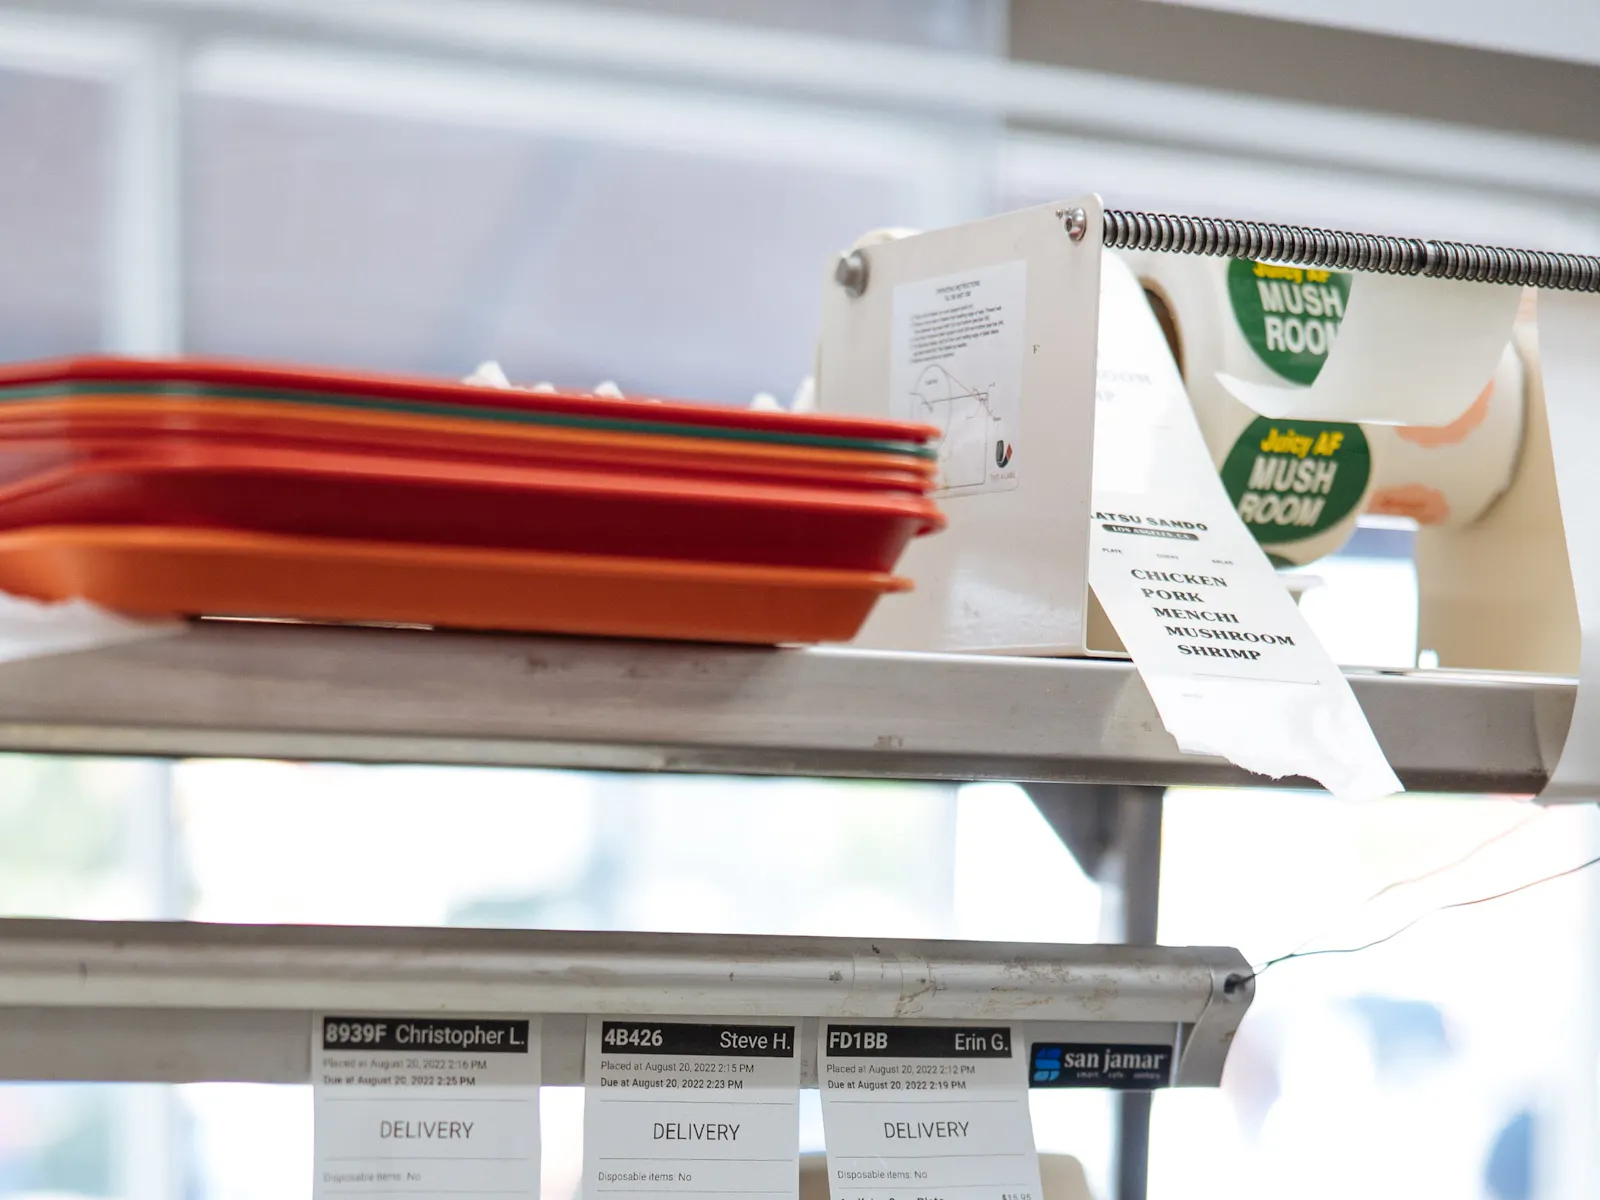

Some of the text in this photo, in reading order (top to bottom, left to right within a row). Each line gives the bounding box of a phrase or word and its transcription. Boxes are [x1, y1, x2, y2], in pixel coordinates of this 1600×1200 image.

[1257, 280, 1344, 318] MUSH
[1260, 427, 1344, 458] Juicy AF
[1248, 454, 1338, 495] MUSH
[1237, 492, 1326, 526] ROOM
[1091, 512, 1208, 530] ATSU SANDO
[1131, 569, 1227, 587] CHICKEN
[1141, 588, 1205, 603] PORK
[1153, 607, 1240, 623] MENCHI
[1165, 626, 1295, 646] MUSHROOM
[1178, 644, 1261, 660] SHRIMP
[326, 1023, 524, 1047] 8939F Christopher L.
[605, 1029, 790, 1050] 4B426 Steve H.
[829, 1032, 1008, 1051] FD1BB Erin G.
[601, 1062, 631, 1071] Placed
[634, 1063, 642, 1071] at
[646, 1063, 676, 1073] August
[695, 1064, 715, 1072] 2022
[718, 1064, 737, 1073] 2:15
[740, 1064, 754, 1073] PM
[1064, 1049, 1163, 1073] san jamar
[601, 1078, 618, 1087] Due
[621, 1079, 629, 1087] at
[632, 1078, 663, 1089] August
[682, 1080, 704, 1088] 2022
[706, 1080, 725, 1089] 2:23
[728, 1081, 743, 1089] PM
[828, 1080, 844, 1089] Due
[847, 1081, 855, 1089] at
[858, 1081, 888, 1091] August
[906, 1081, 928, 1089] 2022
[930, 1081, 949, 1089] 2:19
[951, 1081, 966, 1089] PM
[380, 1121, 474, 1139] DELIVERY
[653, 1123, 740, 1140] DELIVERY
[885, 1121, 969, 1139] DELIVERY
[598, 1172, 646, 1183] Disposable
[678, 1173, 692, 1181] No
